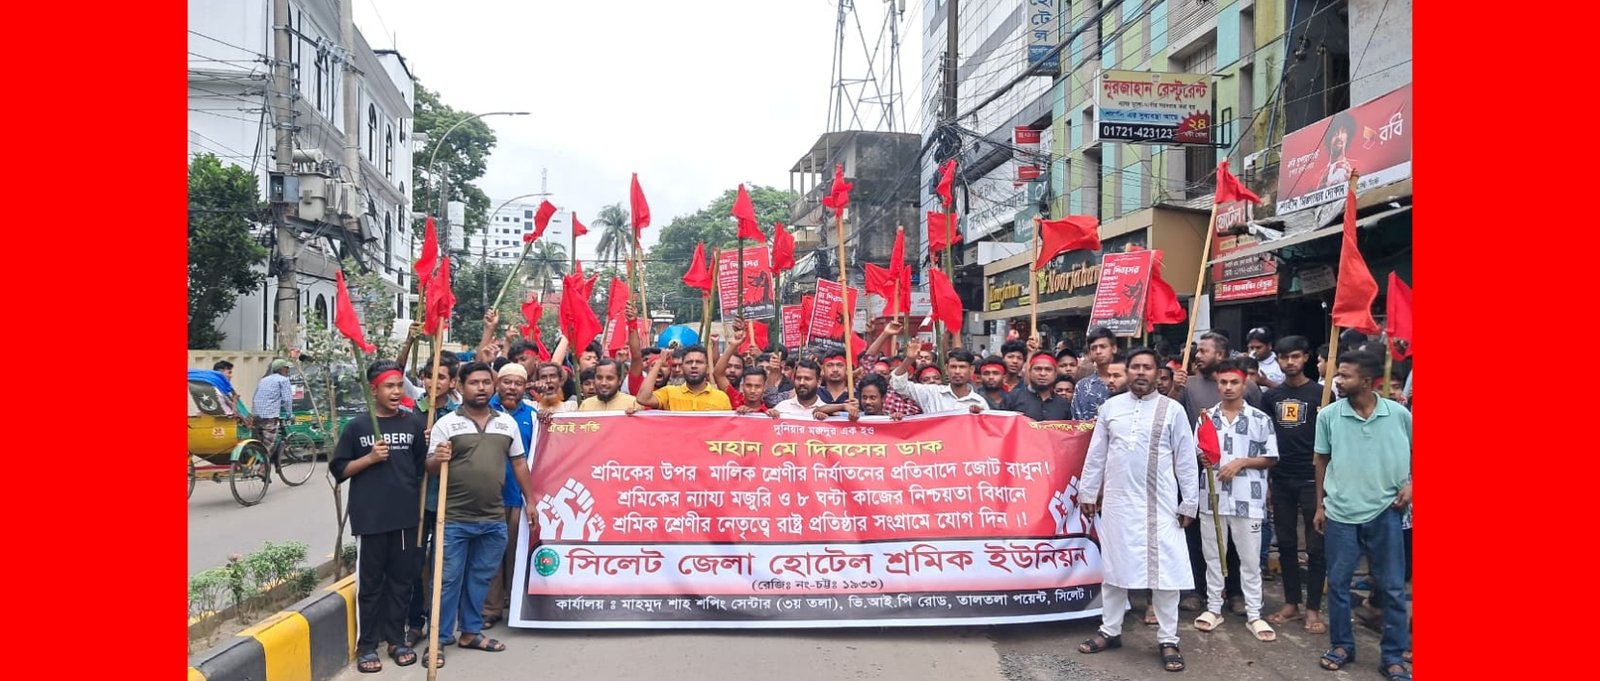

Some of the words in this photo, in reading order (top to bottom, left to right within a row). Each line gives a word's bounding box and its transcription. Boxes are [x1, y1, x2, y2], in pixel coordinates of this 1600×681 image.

[1103, 80, 1153, 100] নূরজাহান
[1157, 80, 1208, 101] রেস্টুরেন্ট
[1103, 125, 1173, 139] 01721-423123
[1189, 118, 1206, 130] ২৪
[1379, 111, 1403, 145] রবি
[1286, 406, 1297, 418] R
[579, 420, 601, 433] শক্তি
[773, 422, 804, 436] দুনিয়ার
[808, 426, 837, 437] মজদুর
[841, 426, 857, 435] এক
[859, 425, 875, 436] হও
[705, 439, 763, 458] মহান
[771, 441, 798, 457] মে
[805, 439, 888, 458] দিবসের
[896, 439, 943, 457] ডাক
[592, 460, 655, 481] শ্রমিকের
[660, 461, 697, 481] উপর
[709, 460, 757, 482] মালিক
[762, 461, 808, 483] শ্রেণীর
[813, 461, 886, 483] নির্যাতনের
[891, 460, 957, 480] প্রতিবাদে
[962, 456, 1001, 477] জোট
[1005, 460, 1051, 481] বাধুন!
[618, 486, 681, 508] শ্রমিকের
[686, 490, 726, 508] ন্যায্য
[730, 486, 772, 512] মজুরি
[778, 492, 791, 507] ও
[797, 492, 810, 508] ৮
[815, 487, 848, 508] ঘন্টা
[851, 489, 904, 506] কাজের
[909, 484, 973, 506] নিশ্চয়তা
[976, 481, 1028, 504] বিধানে
[612, 511, 659, 535] শ্রমিক
[663, 511, 712, 534] শ্রেণীর
[716, 517, 771, 541] নেতৃত্বে
[776, 511, 804, 536] রাষ্ট্র
[808, 510, 868, 533] প্রতিষ্ঠার
[872, 512, 931, 532] সংগ্রামে
[936, 511, 974, 530] যোগ
[978, 506, 1009, 529] দিন
[565, 547, 665, 576] সিলেট
[678, 551, 756, 577] জেলা
[769, 546, 874, 578] হোটেল
[884, 543, 974, 577] শ্রমিক
[984, 542, 1089, 573] ইউনিয়ন
[843, 578, 884, 591] ১৯৩৩)
[555, 595, 605, 611] কার্যালয়
[620, 599, 663, 613] মাহমুদ
[667, 598, 692, 611] শাহ
[695, 595, 728, 611] শপিং
[731, 595, 772, 611] সেন্টার
[776, 597, 802, 612] (৩য়
[805, 597, 844, 612] তলা),
[917, 595, 953, 610] রোড,
[955, 593, 1009, 607] তালতলা
[1012, 590, 1051, 605] পয়েন্ট,
[1054, 587, 1086, 603] সিলেট
